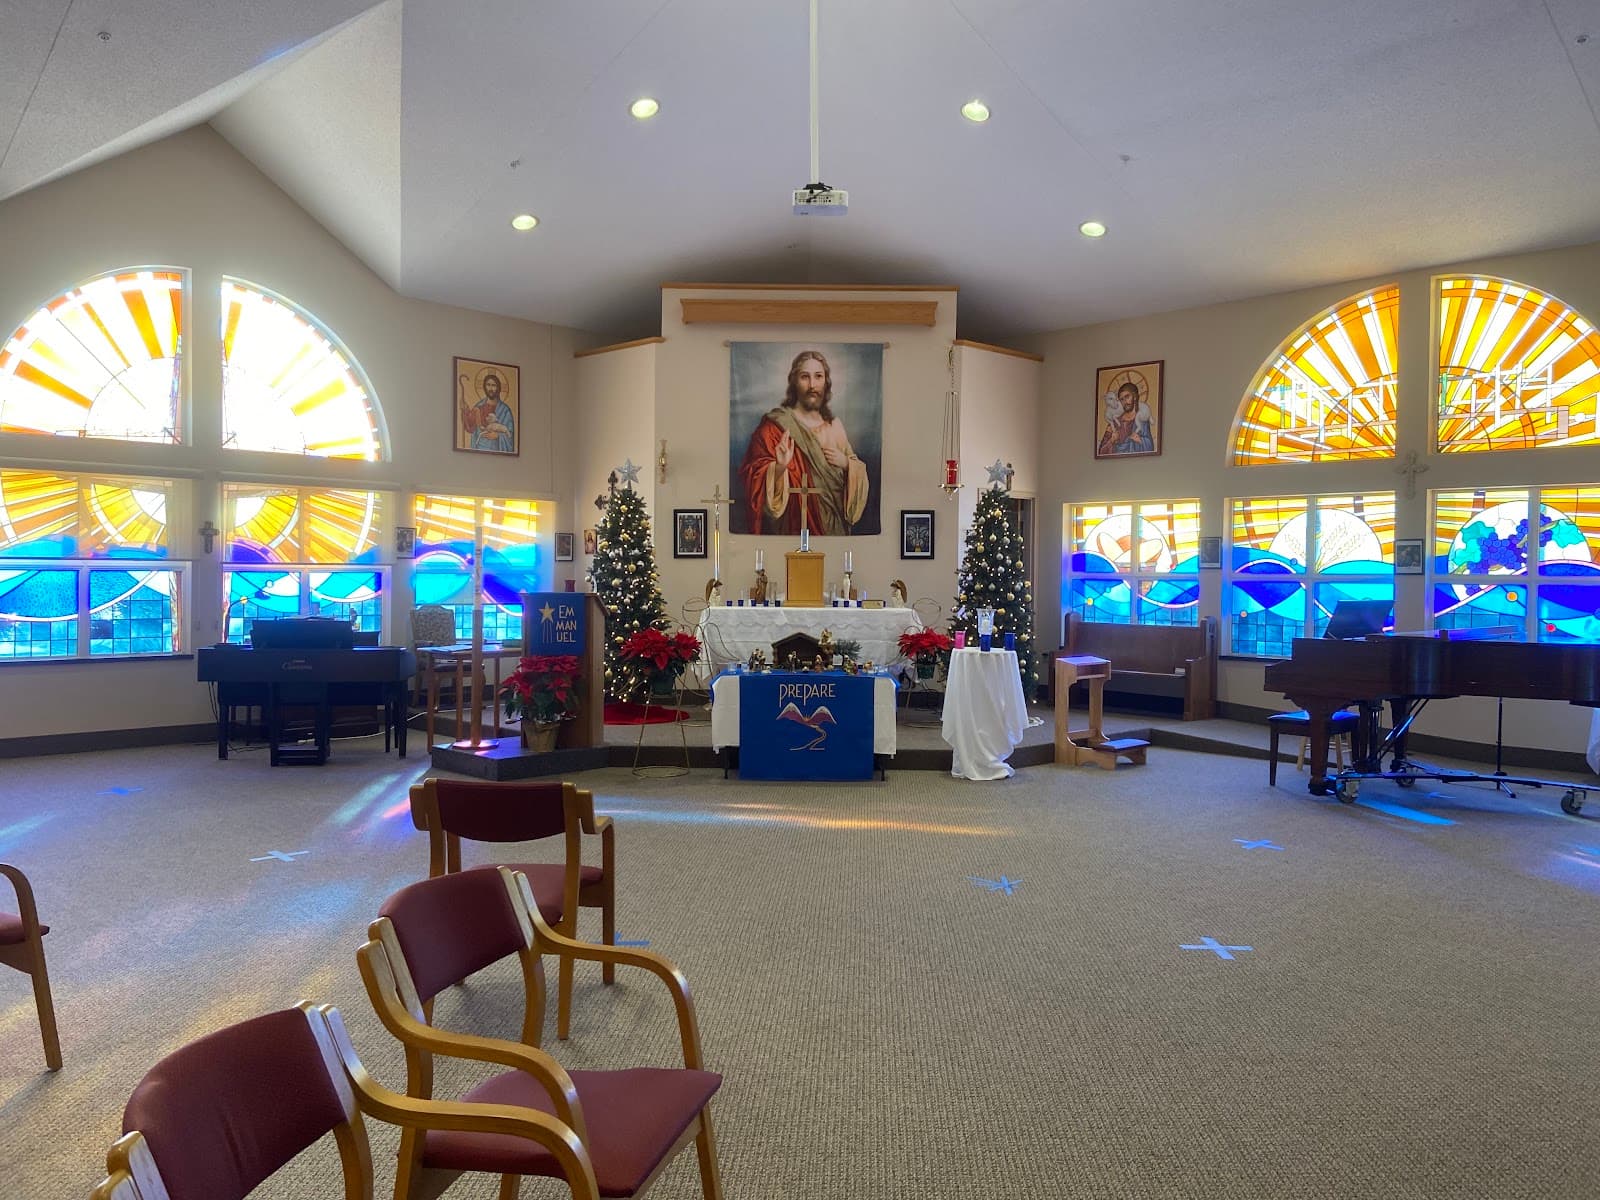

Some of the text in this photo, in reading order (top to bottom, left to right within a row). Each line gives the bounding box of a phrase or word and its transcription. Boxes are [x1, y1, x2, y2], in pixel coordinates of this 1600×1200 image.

[559, 605, 575, 618] EM
[555, 620, 577, 631] MAN
[556, 631, 577, 643] UEL
[779, 683, 837, 708] PREPARE
